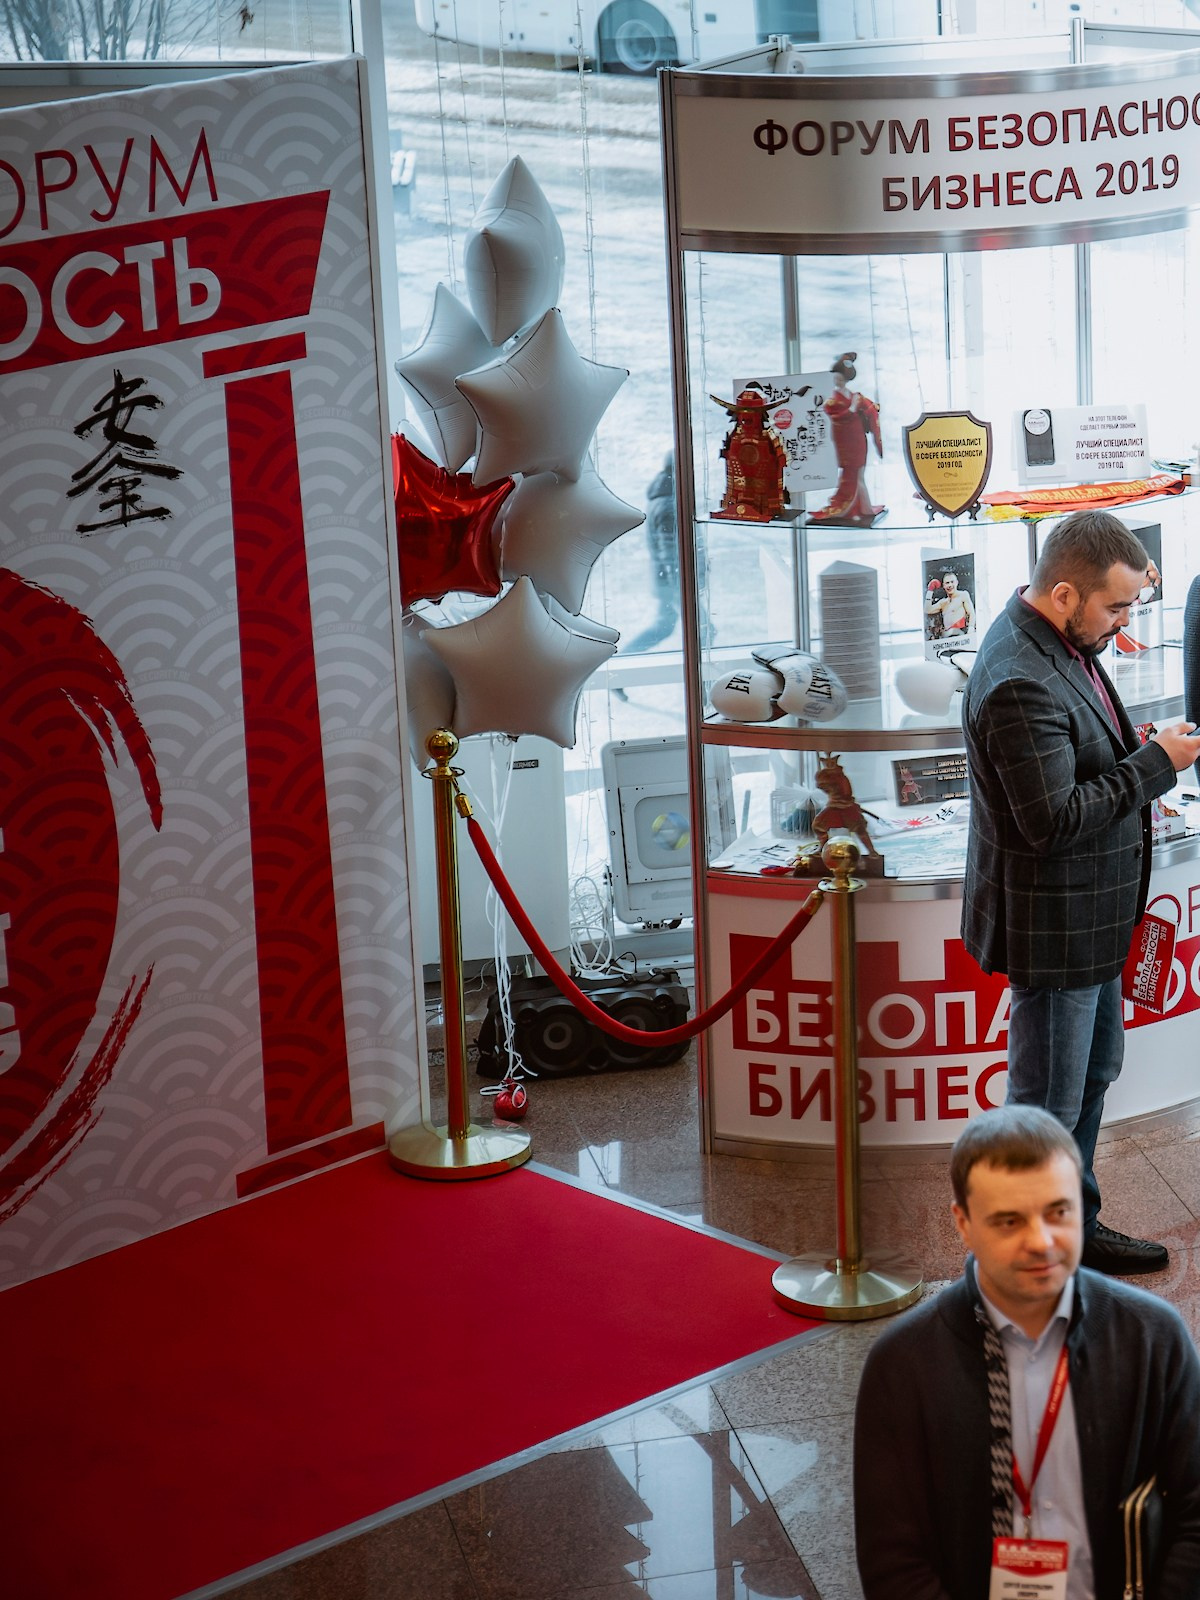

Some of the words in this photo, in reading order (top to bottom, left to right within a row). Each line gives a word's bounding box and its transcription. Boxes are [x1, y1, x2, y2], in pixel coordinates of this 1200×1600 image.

[753, 118, 931, 157] ФОРУМ
[882, 166, 1082, 213] БИЗНЕСА
[1096, 154, 1180, 198] 2019
[915, 438, 942, 449] ЛУЧШИЙ
[942, 438, 981, 448] СПЕЦИАЛИСТ
[1076, 438, 1102, 449] ЛУЧШИЙ
[1103, 438, 1143, 448] СПЕЦИАЛИСТ
[920, 452, 939, 460] СФЕРЕ
[940, 450, 983, 459] БЕЗОПАСНОСТИ
[1081, 452, 1100, 460] СФЕРЕ
[1101, 450, 1145, 459] БЕЗОПАСНОСТИ
[937, 461, 950, 469] 2019
[1113, 461, 1124, 469] ГОД
[1140, 920, 1151, 952] ФОРУМ
[1139, 924, 1159, 999] БЕЗОПАСНОСТЬ
[1147, 960, 1162, 1002] БИЗНЕСА
